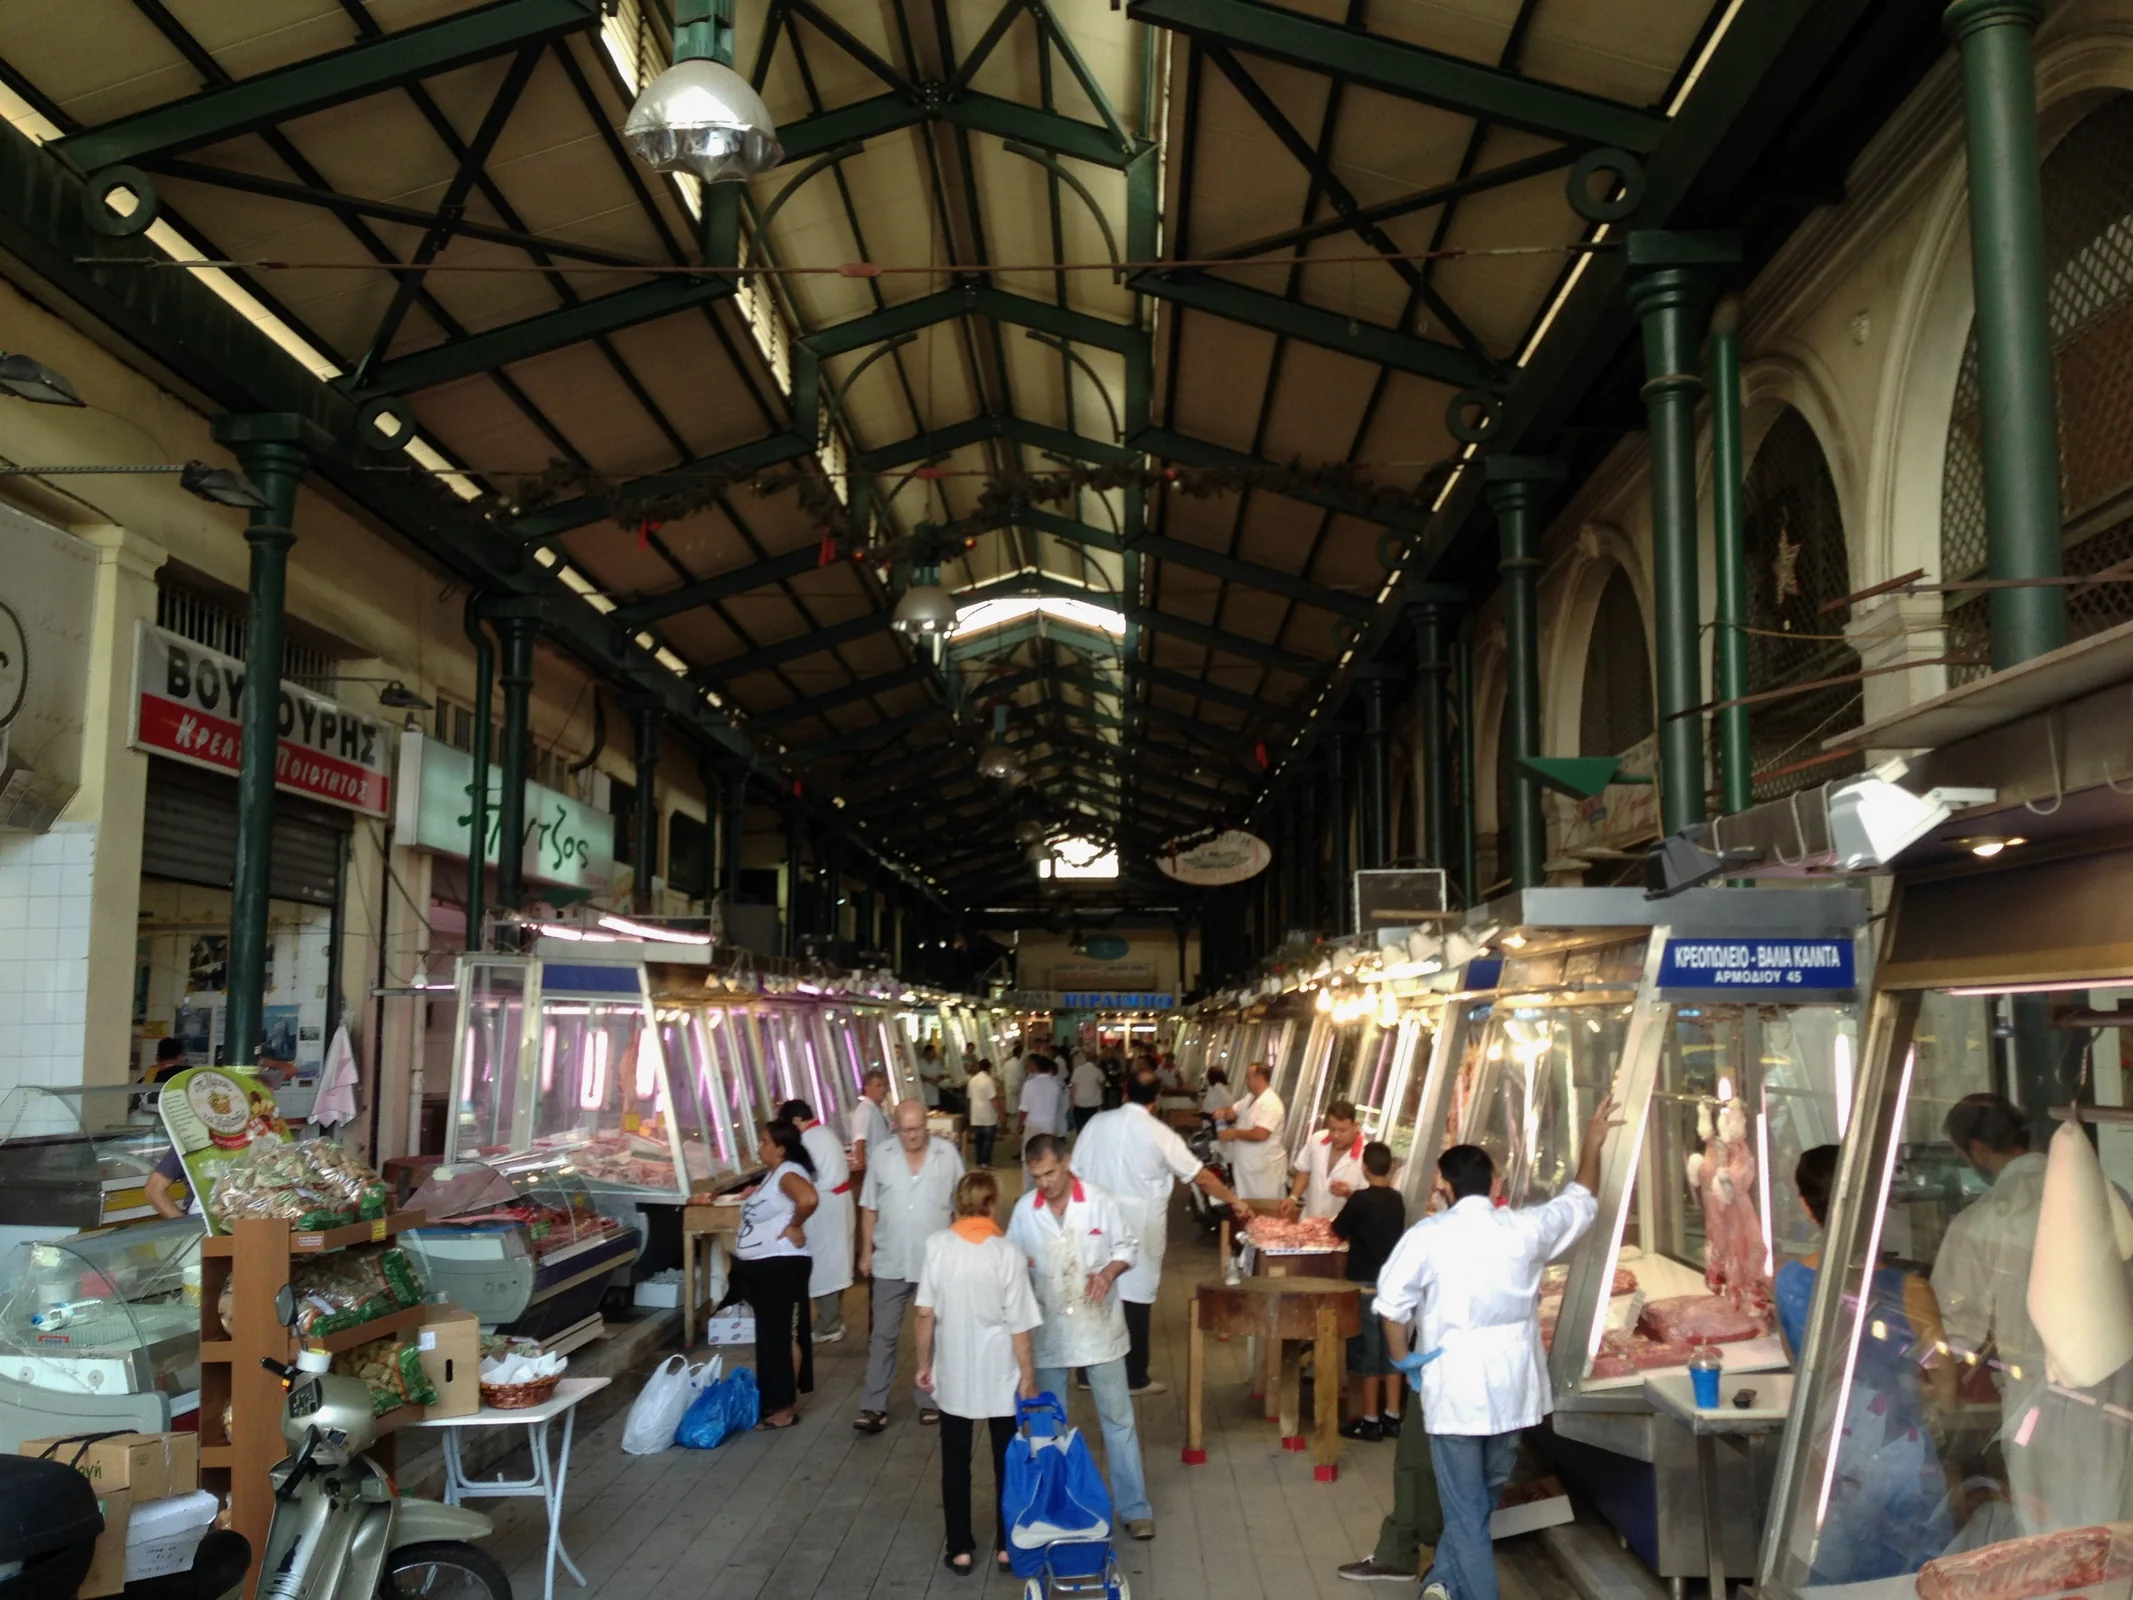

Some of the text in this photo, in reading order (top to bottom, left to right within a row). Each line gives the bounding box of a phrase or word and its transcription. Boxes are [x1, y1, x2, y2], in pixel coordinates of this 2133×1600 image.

[168, 645, 376, 766] ΒΟΥΟΥΡΗΣ
[1674, 946, 1750, 968] ΚΡΕΟΠΩΛΕΙΟ
[1714, 971, 1803, 984] ΑΡΜΟΔΙΟΥ 45
